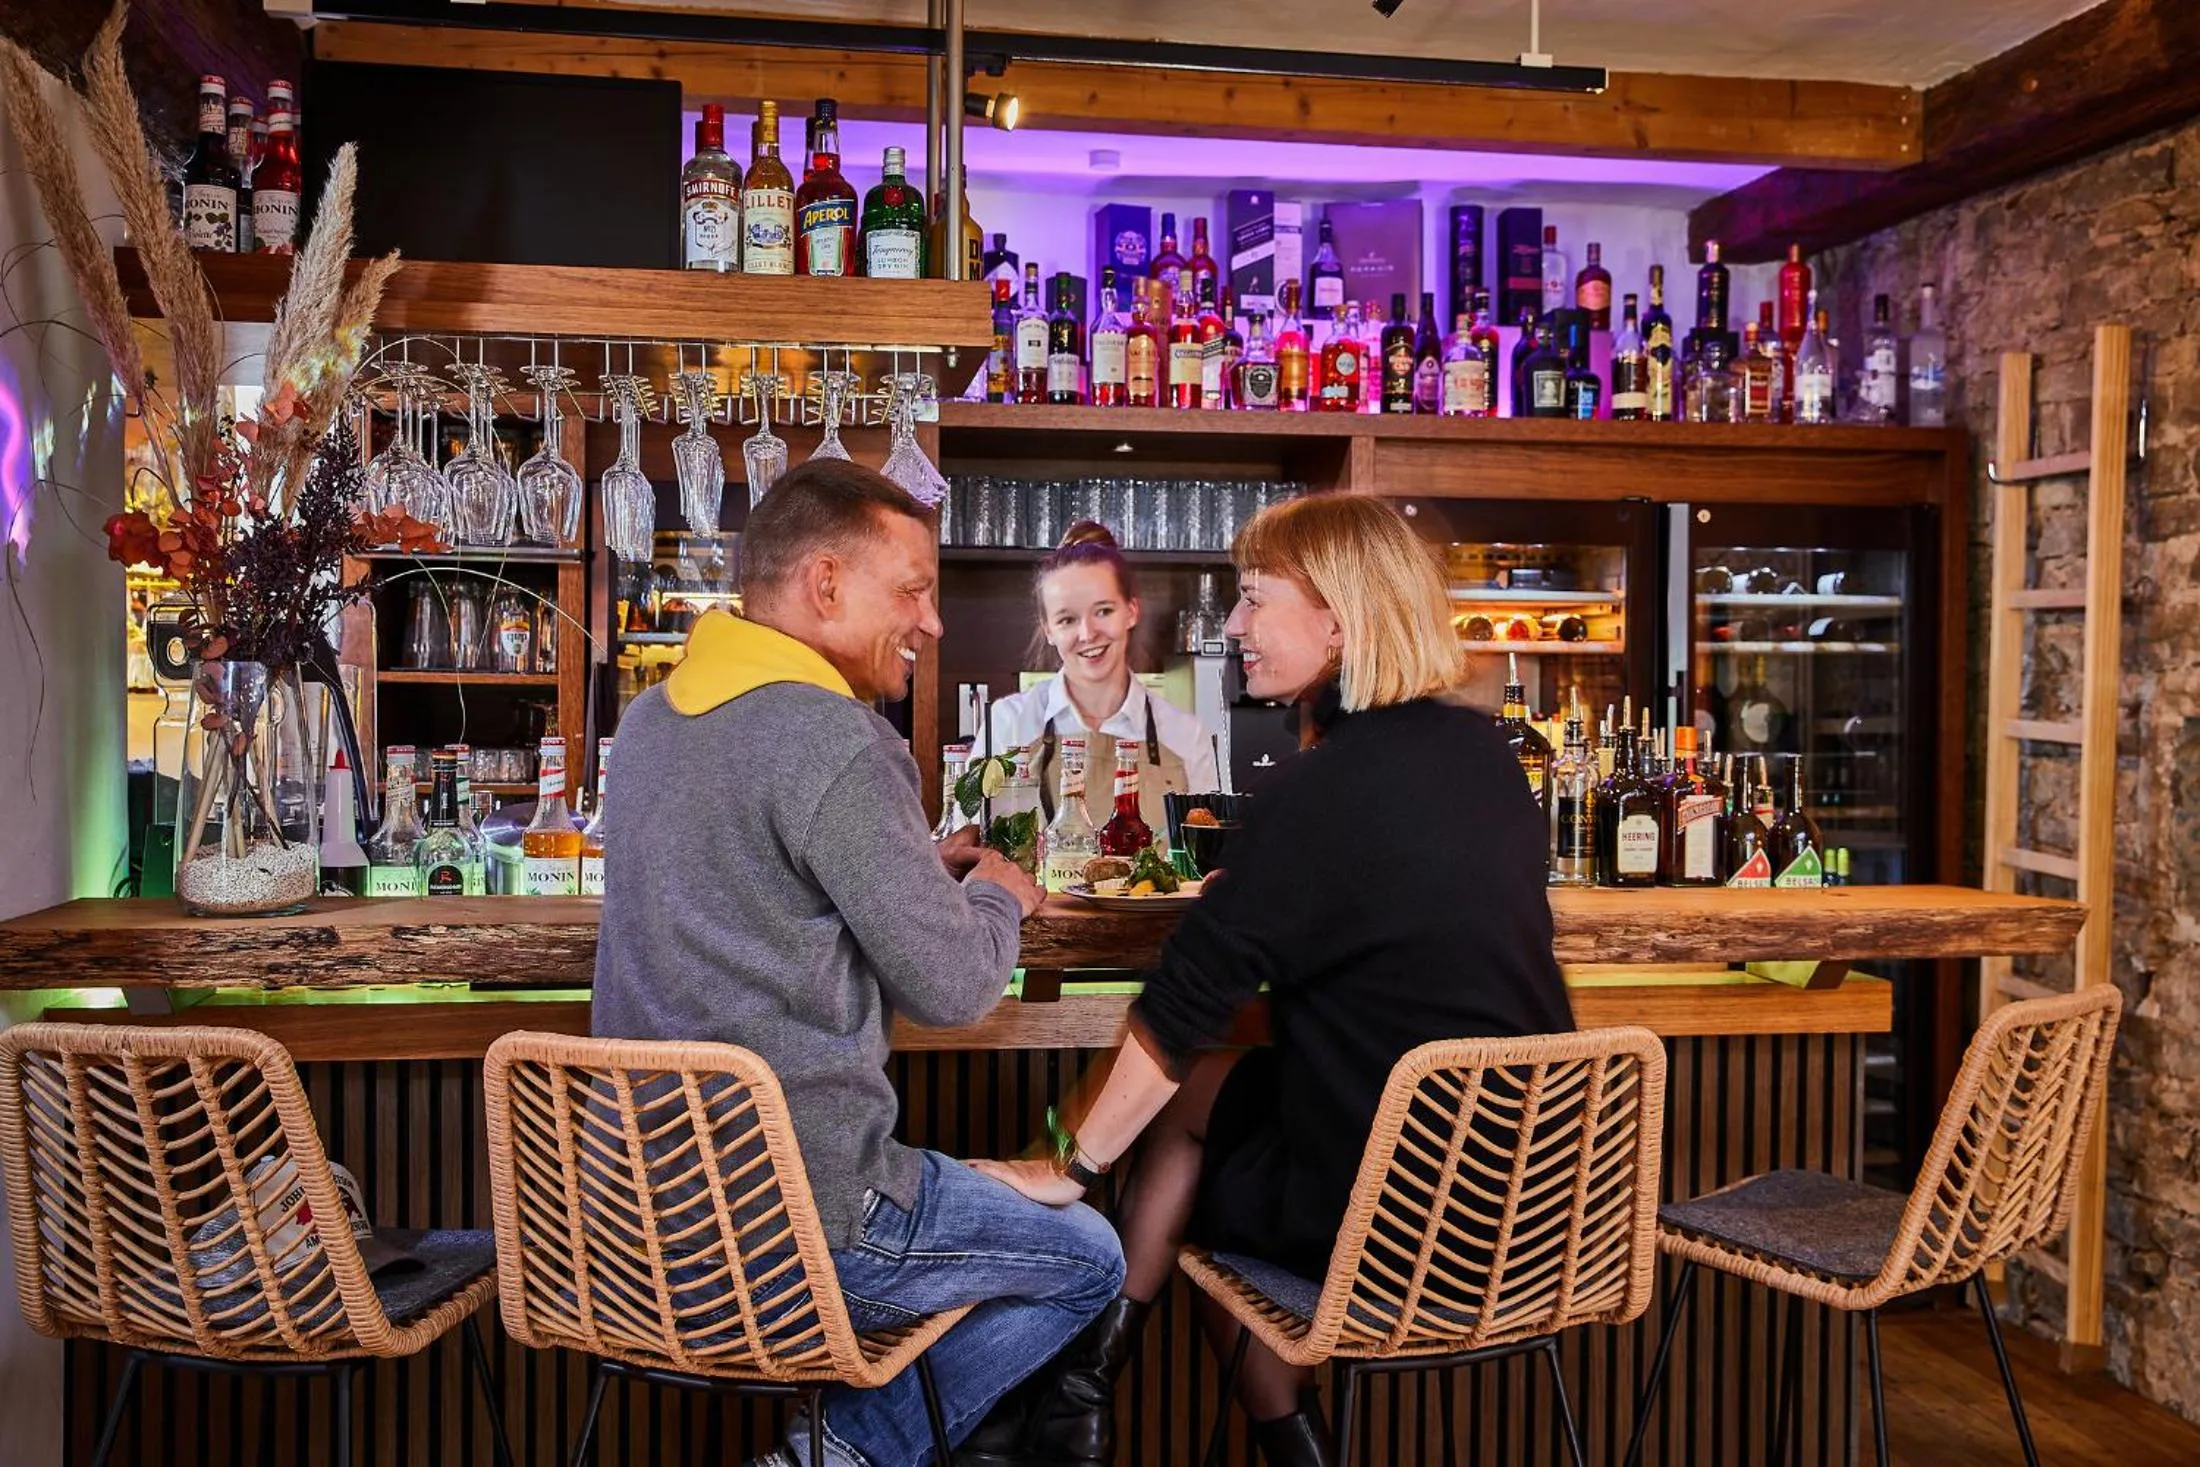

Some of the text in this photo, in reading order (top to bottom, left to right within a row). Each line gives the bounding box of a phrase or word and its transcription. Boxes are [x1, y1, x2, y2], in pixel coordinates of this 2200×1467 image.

[686, 181, 736, 198] SMIRNOFF
[803, 208, 850, 230] APEROL
[1622, 831, 1655, 842] HEERING
[528, 872, 575, 882] MONIN
[1051, 869, 1083, 879] MON
[376, 882, 417, 891] MONI
